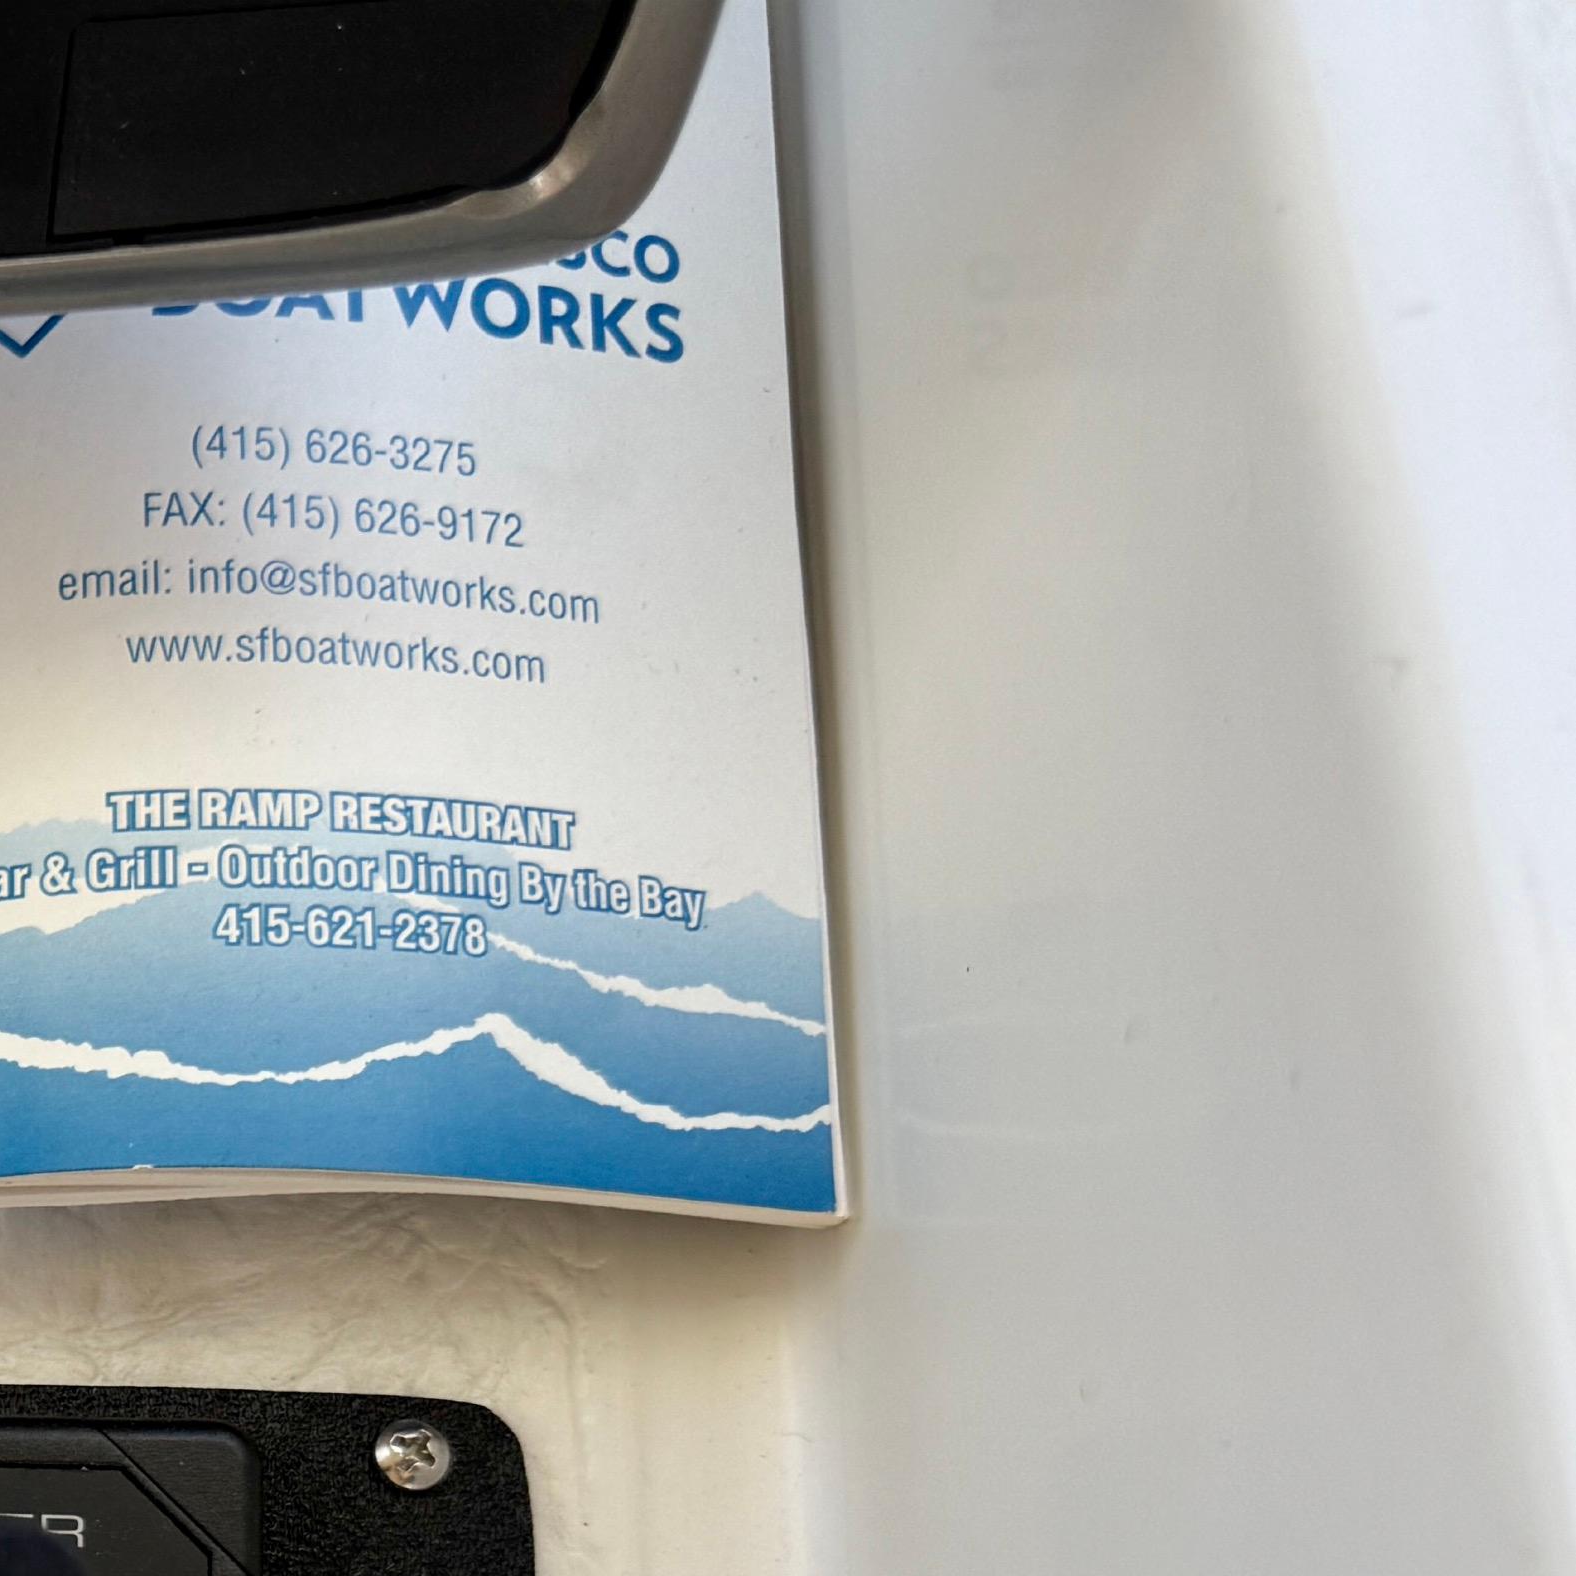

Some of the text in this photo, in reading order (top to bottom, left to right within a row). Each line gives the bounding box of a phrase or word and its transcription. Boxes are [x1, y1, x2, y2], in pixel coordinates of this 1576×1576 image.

[152, 277, 685, 363] WORKS
[191, 425, 477, 477] (415) 626-3275
[143, 491, 524, 548] FAX: (415) 626-9172
[58, 557, 600, 624] email: info@sfboatworks.com
[126, 627, 546, 684] www.sfboatworks.com
[106, 788, 575, 851] THE RAMP RESTAURANT
[40, 853, 77, 895] &
[84, 846, 178, 891] Grill
[217, 846, 379, 893] Outdoor
[387, 850, 511, 910] Dining
[518, 863, 569, 914] By
[571, 867, 632, 916] the
[638, 875, 706, 931] Bay
[213, 903, 490, 957] 415-621-2378
